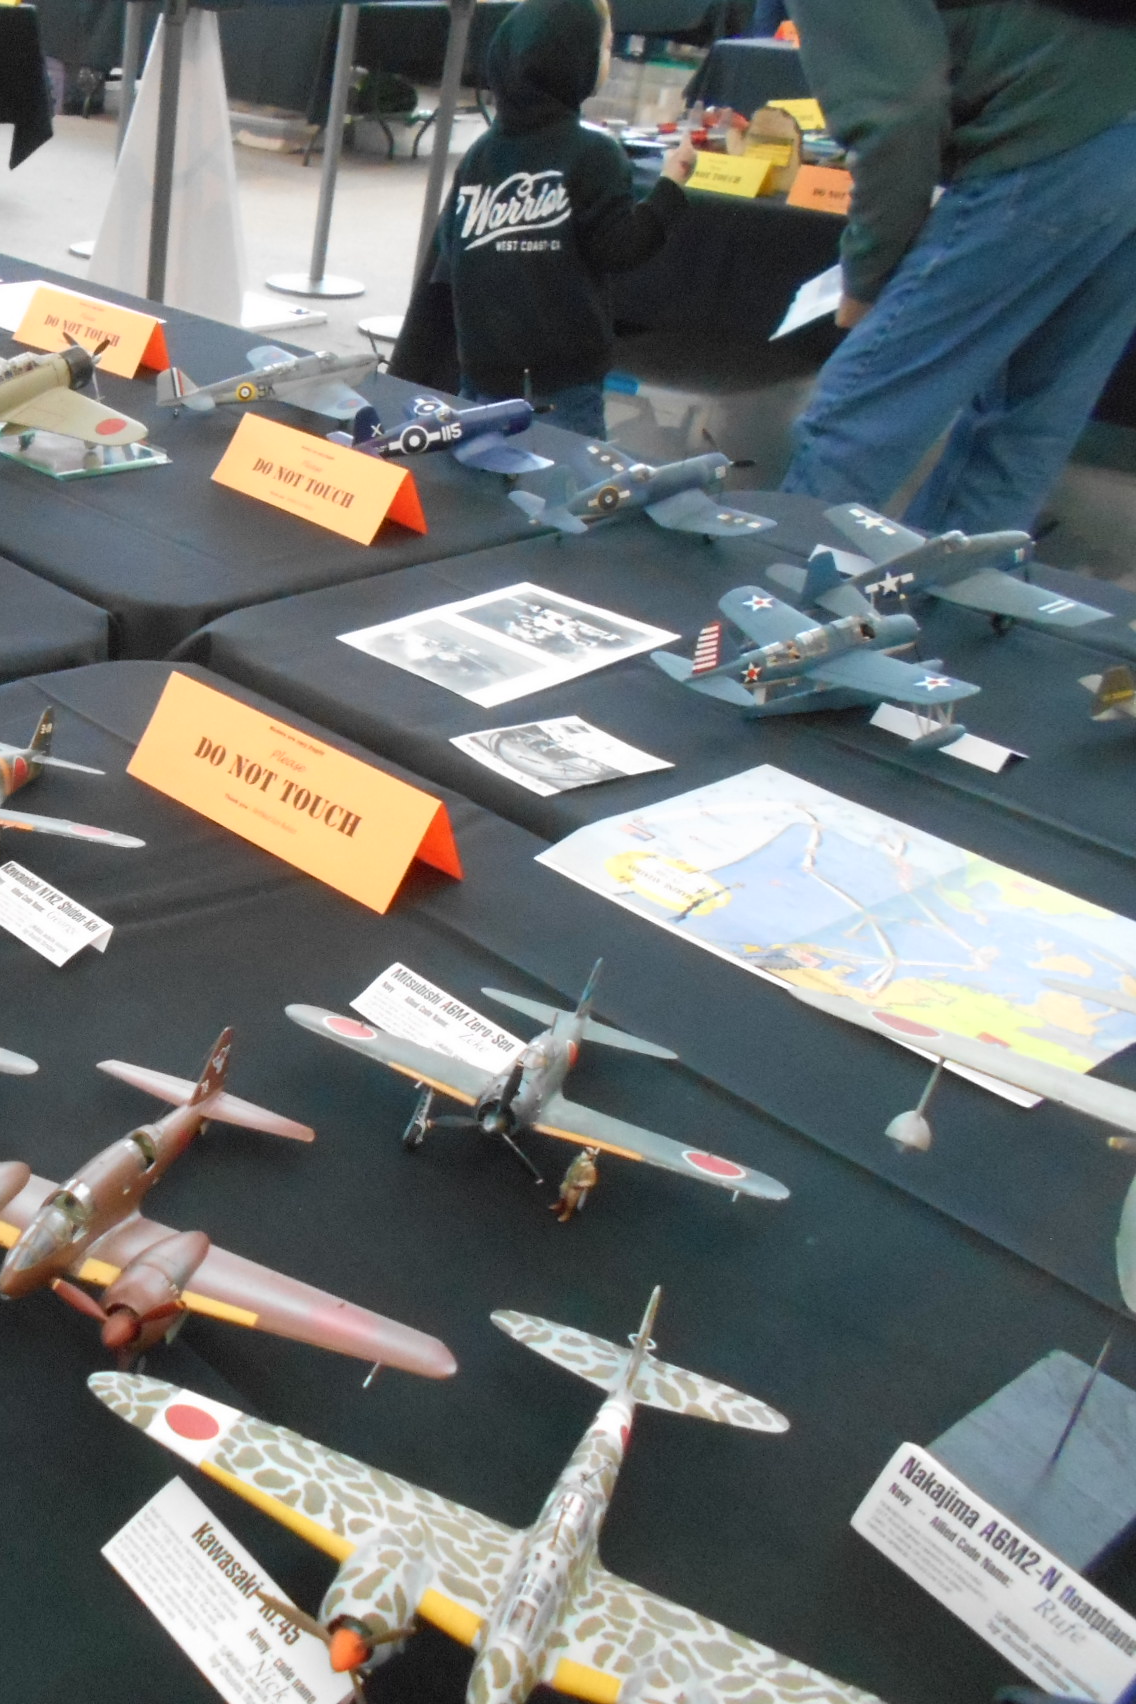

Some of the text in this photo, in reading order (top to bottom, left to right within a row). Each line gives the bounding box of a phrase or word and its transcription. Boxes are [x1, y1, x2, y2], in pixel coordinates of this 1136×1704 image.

[44, 314, 59, 328] DO
[63, 319, 83, 335] NOT
[371, 423, 382, 438] X
[441, 422, 462, 441] 115
[252, 457, 273, 476] DO
[275, 465, 304, 488] NOT
[305, 478, 355, 509] TOUCH
[193, 736, 227, 767] DO
[227, 753, 278, 792] NOT
[280, 779, 363, 838] TOUCH
[269, 749, 307, 773] Please
[35, 885, 64, 906] N1K2
[56, 900, 103, 932] Shiden-Kai
[391, 968, 446, 1006] Mitsubishi
[440, 1001, 469, 1022] A6M
[465, 1016, 516, 1052] Zero-Sen
[888, 1482, 913, 1507] Navy
[930, 1516, 957, 1544] Allied
[956, 1535, 981, 1563] Code
[899, 1456, 981, 1530] Nakajima
[979, 1520, 1064, 1593] A6M2-N
[191, 1521, 264, 1598] Kawasaki
[1034, 1599, 1087, 1645] Rufe
[246, 1627, 271, 1654] Army
[273, 1657, 295, 1681] code
